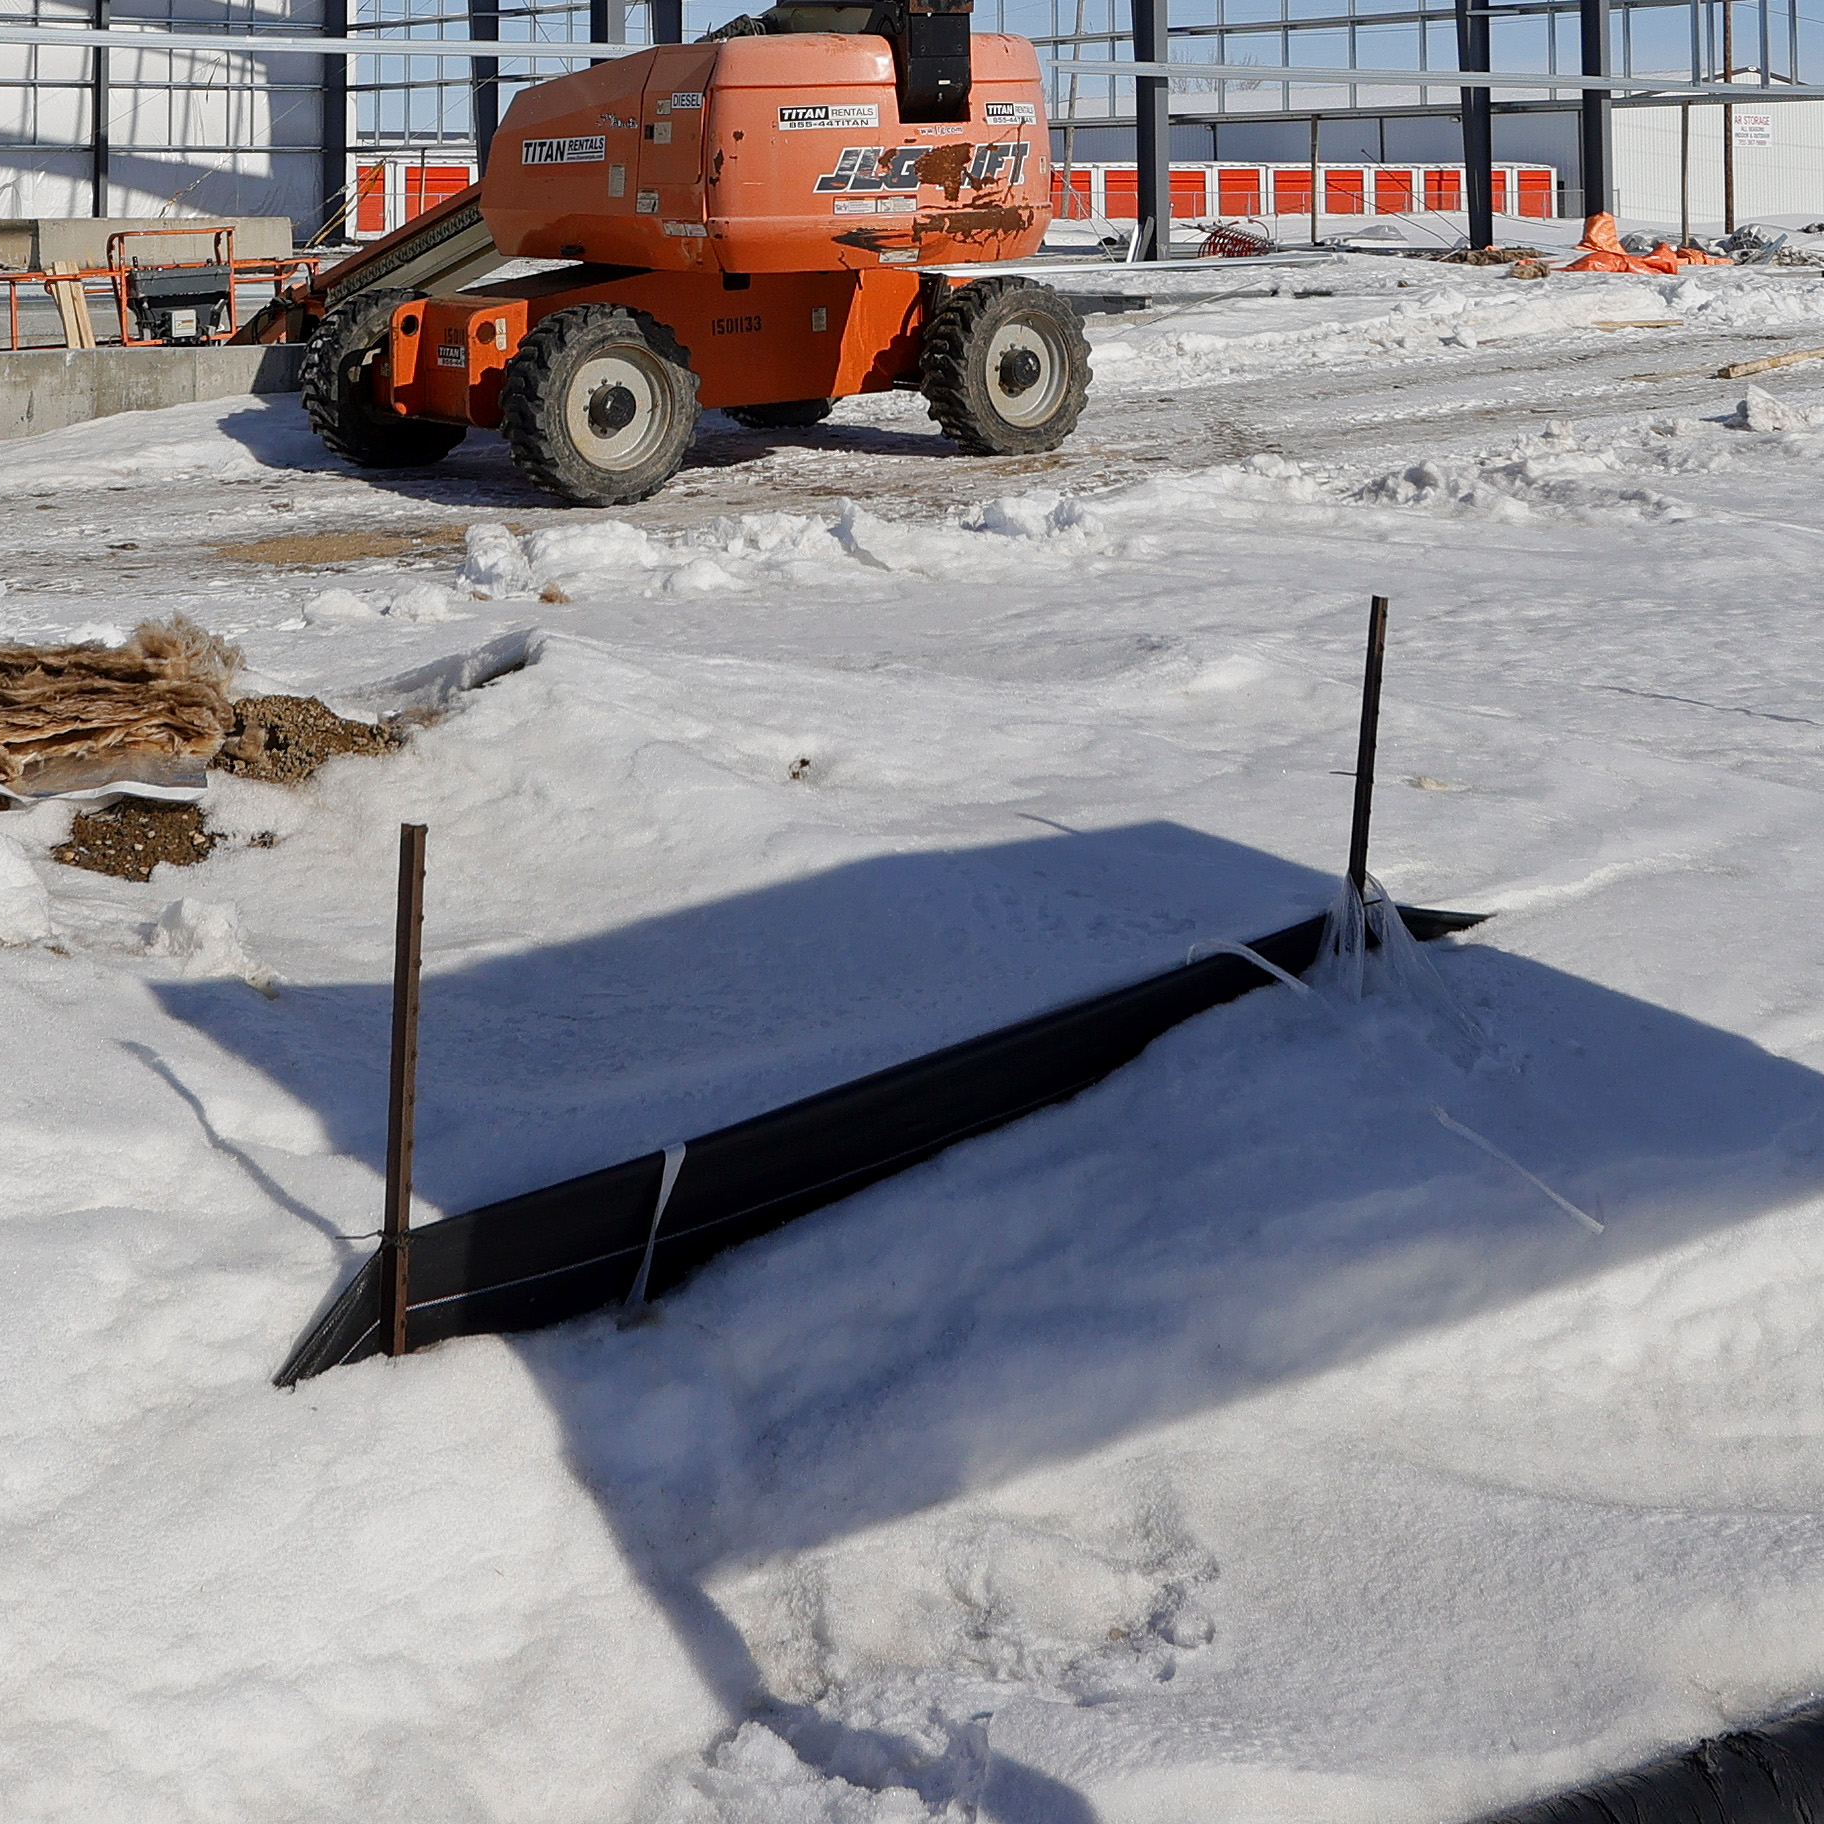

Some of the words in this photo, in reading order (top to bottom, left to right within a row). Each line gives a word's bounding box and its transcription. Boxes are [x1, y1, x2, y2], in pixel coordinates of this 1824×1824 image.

[673, 94, 701, 107] DIESEL
[781, 108, 826, 120] TITAN
[831, 107, 874, 117] RENTALS
[987, 104, 1013, 115] TITAN
[789, 119, 870, 129] 855-44TITAN
[524, 140, 566, 163] TITAN
[567, 137, 604, 151] RENTALS
[712, 316, 762, 336] 1501133
[439, 346, 459, 358] TITAN
